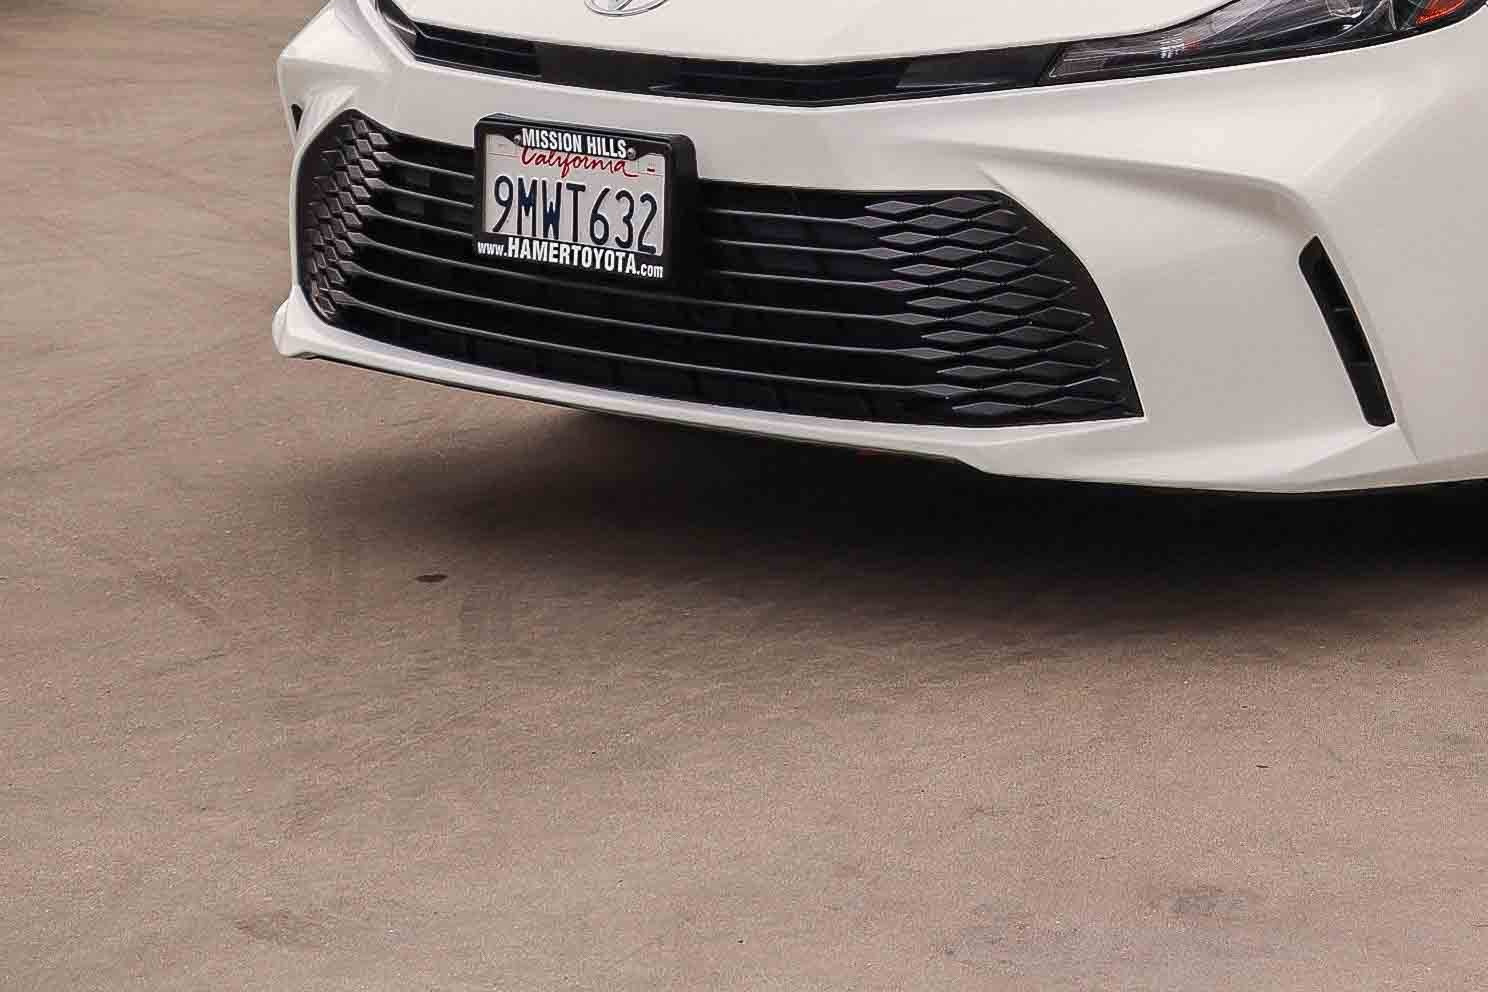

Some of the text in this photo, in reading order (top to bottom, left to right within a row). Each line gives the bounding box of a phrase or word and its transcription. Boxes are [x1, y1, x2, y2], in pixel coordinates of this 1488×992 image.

[521, 127, 627, 159] MISSION HILLS
[521, 146, 639, 178] California
[492, 175, 659, 254] 9MWT632
[477, 237, 664, 279] www.HAMERTOYOTA.com
